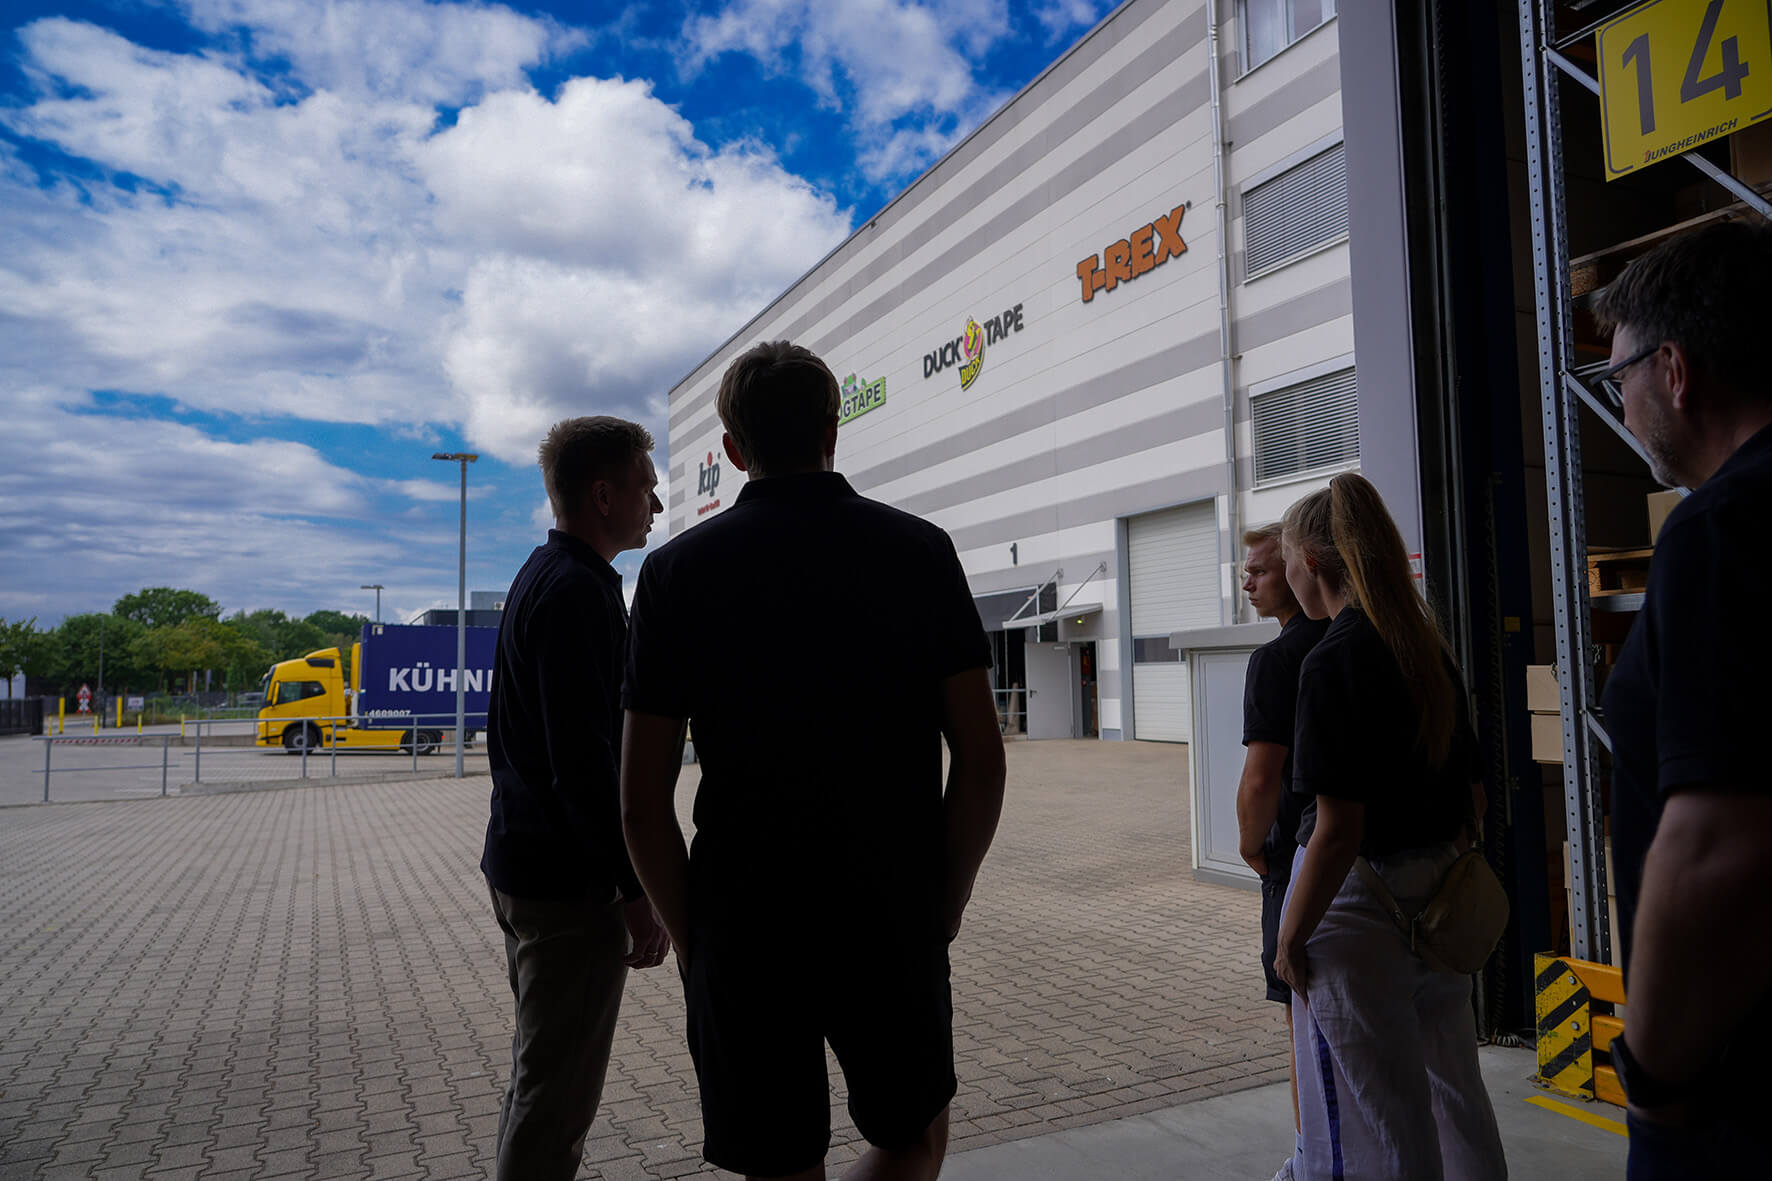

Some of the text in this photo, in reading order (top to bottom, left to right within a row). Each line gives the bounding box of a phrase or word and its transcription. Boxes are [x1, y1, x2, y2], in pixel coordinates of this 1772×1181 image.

[1622, 0, 1750, 136] 14
[1643, 117, 1738, 163] JUNGHEINRICH
[1076, 203, 1188, 304] T-REX
[923, 302, 1024, 379] DUCK TAPE
[839, 382, 881, 419] GTAPE
[697, 451, 720, 497] kip
[1010, 542, 1018, 566] 1
